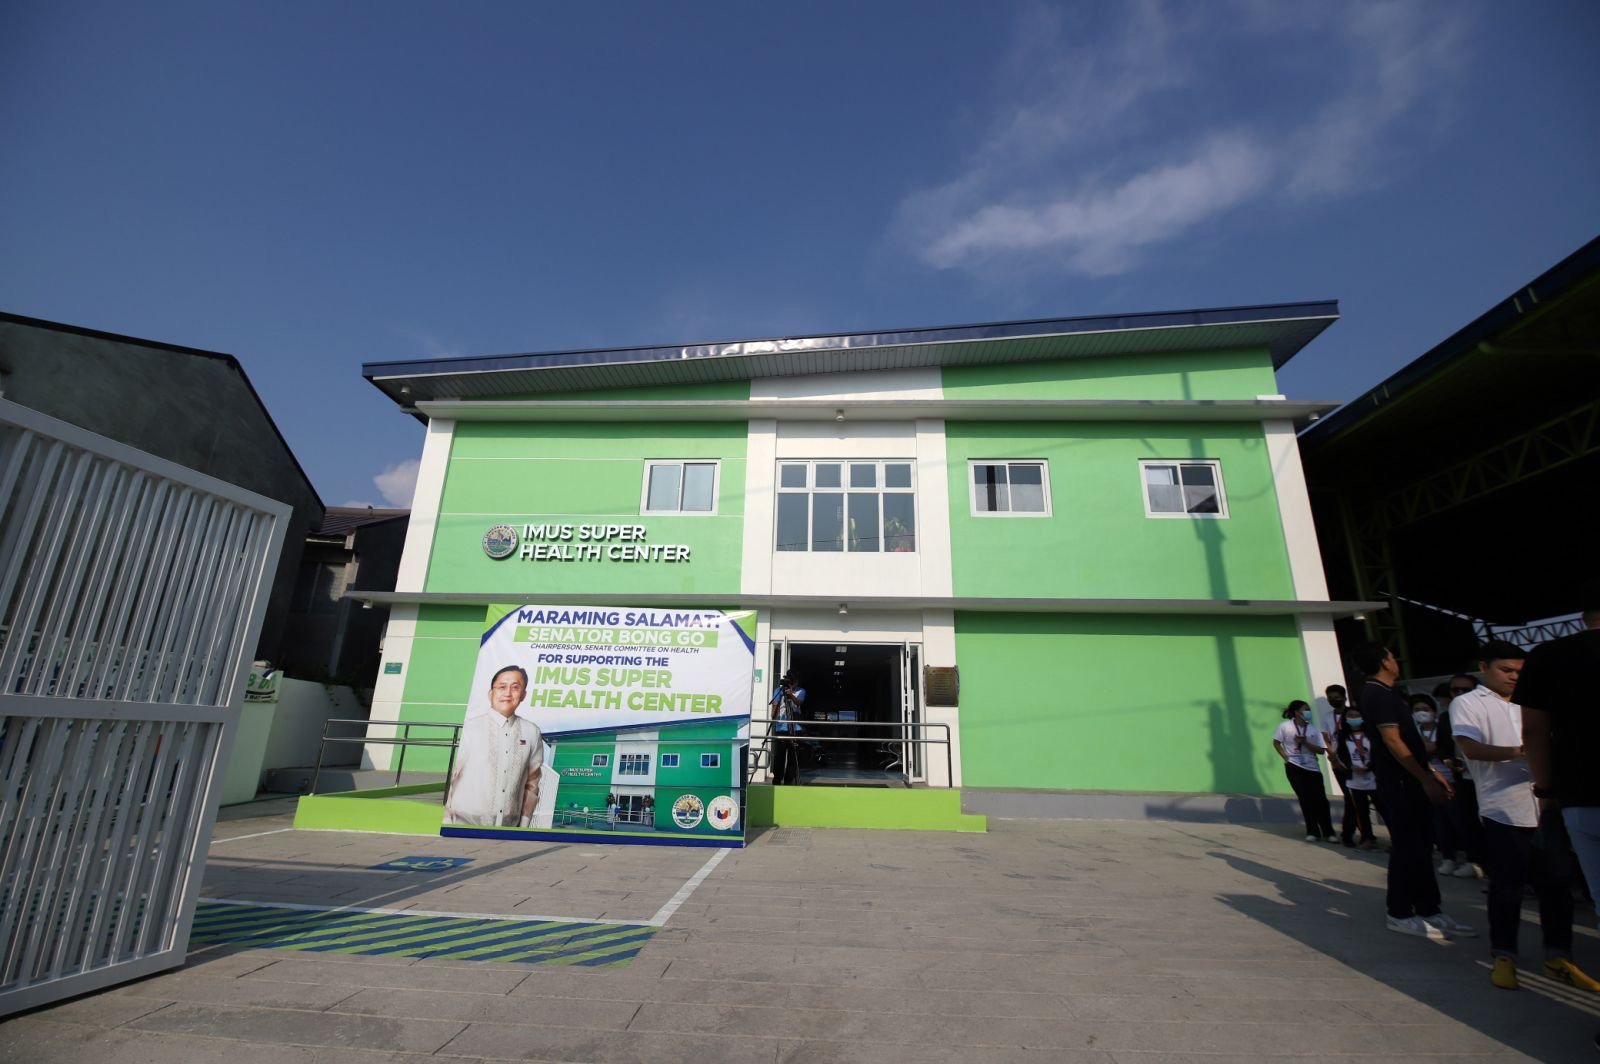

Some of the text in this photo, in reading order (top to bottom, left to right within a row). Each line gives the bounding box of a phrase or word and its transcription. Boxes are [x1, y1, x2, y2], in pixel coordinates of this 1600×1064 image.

[522, 523, 573, 541] IMUS
[578, 524, 647, 542] SUPER
[519, 543, 691, 562] HEALTH CENTER
[517, 609, 620, 626] MARAMING
[527, 627, 705, 646] SENATOR BONG GO
[530, 643, 582, 651] CHAIRPERSON,
[584, 644, 612, 652] SENATE
[613, 645, 656, 653] COMMITTEE
[670, 646, 700, 654] HEALTH
[537, 653, 669, 667] FOR SUPPORTING THE
[534, 666, 673, 688] IMUS SUPER
[530, 688, 723, 713] HEALTH CENTER
